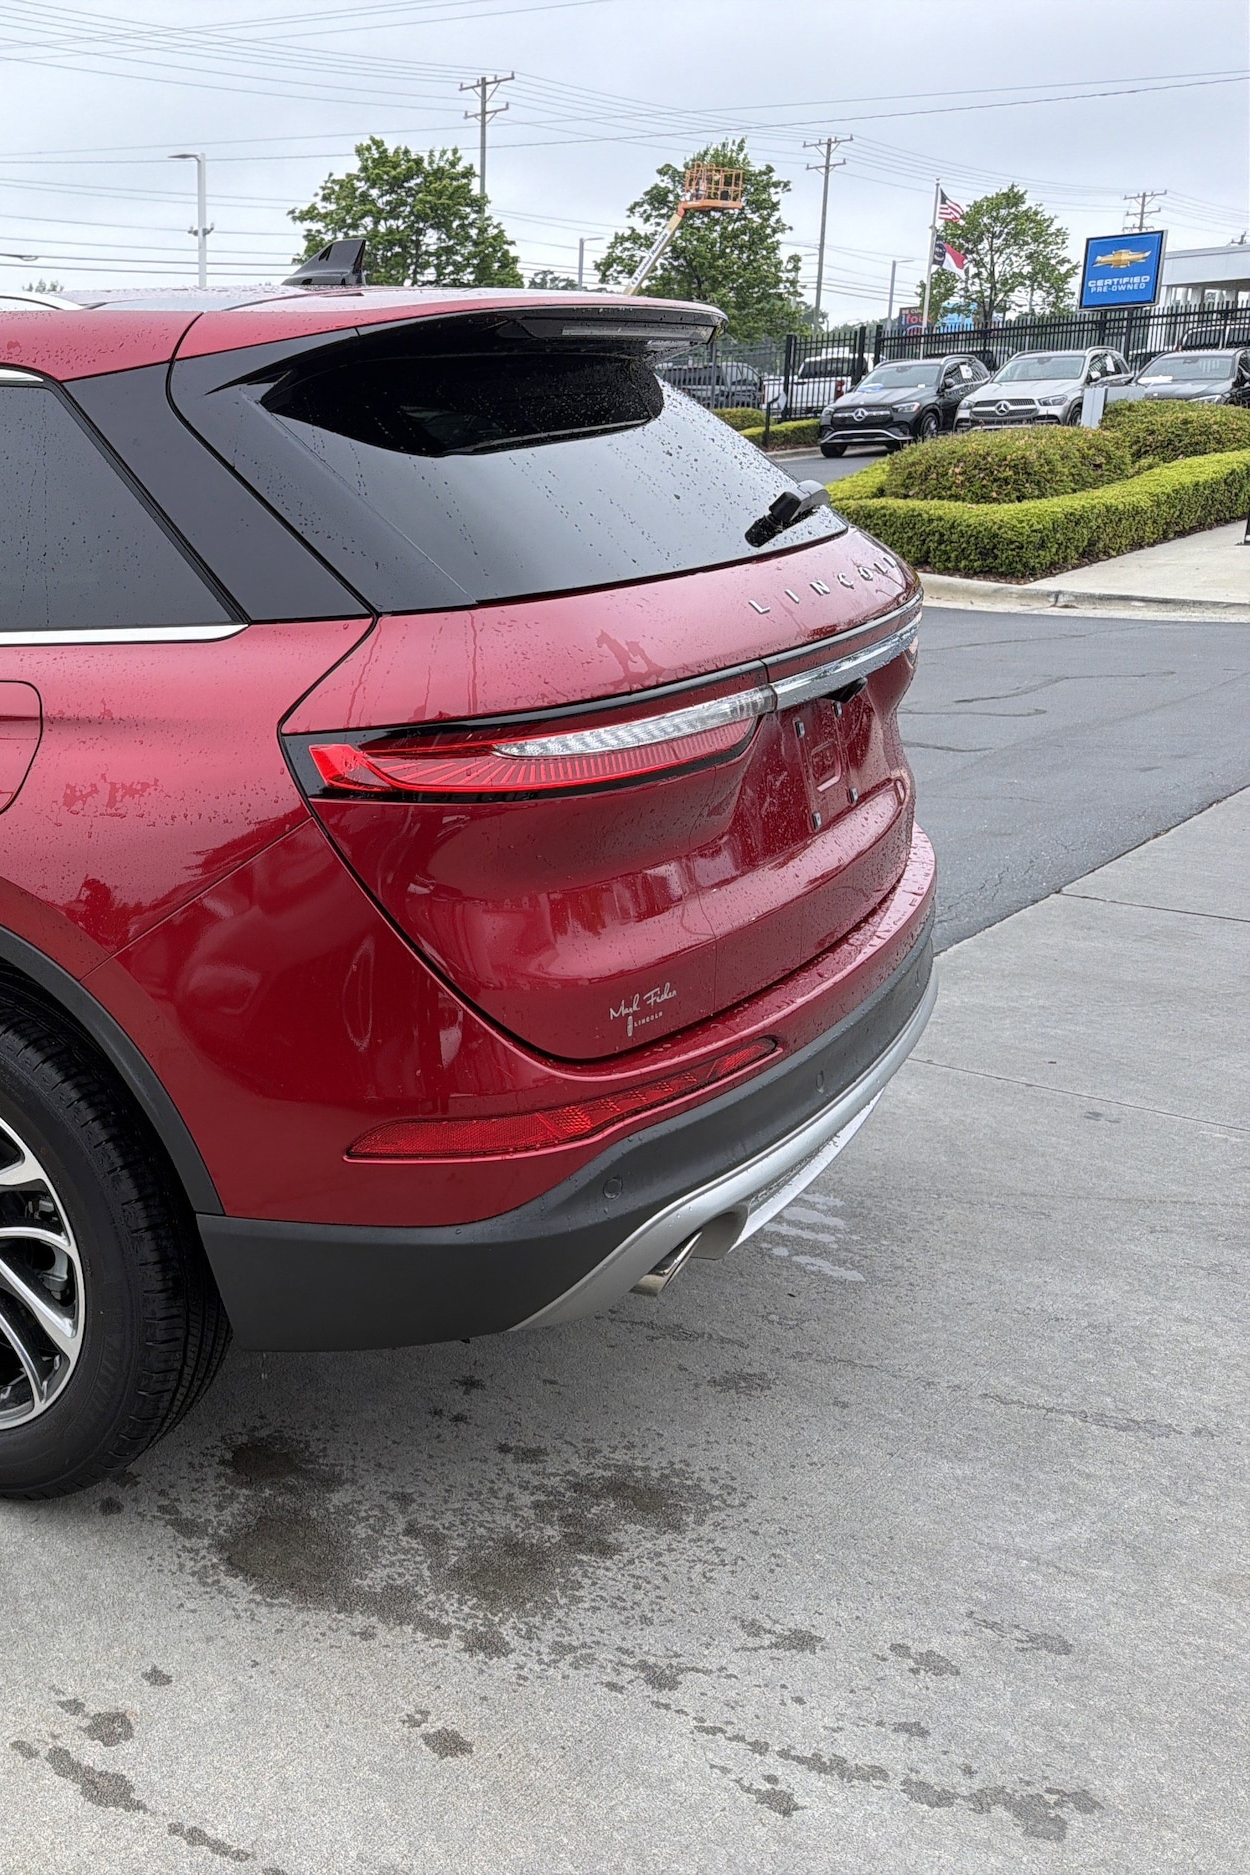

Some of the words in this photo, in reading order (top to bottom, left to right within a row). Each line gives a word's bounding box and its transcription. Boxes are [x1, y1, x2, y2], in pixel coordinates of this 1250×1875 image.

[1088, 275, 1150, 287] CERTIFIED
[1091, 283, 1145, 293] PRE-OWNED
[634, 1012, 663, 1027] LINCOLN
